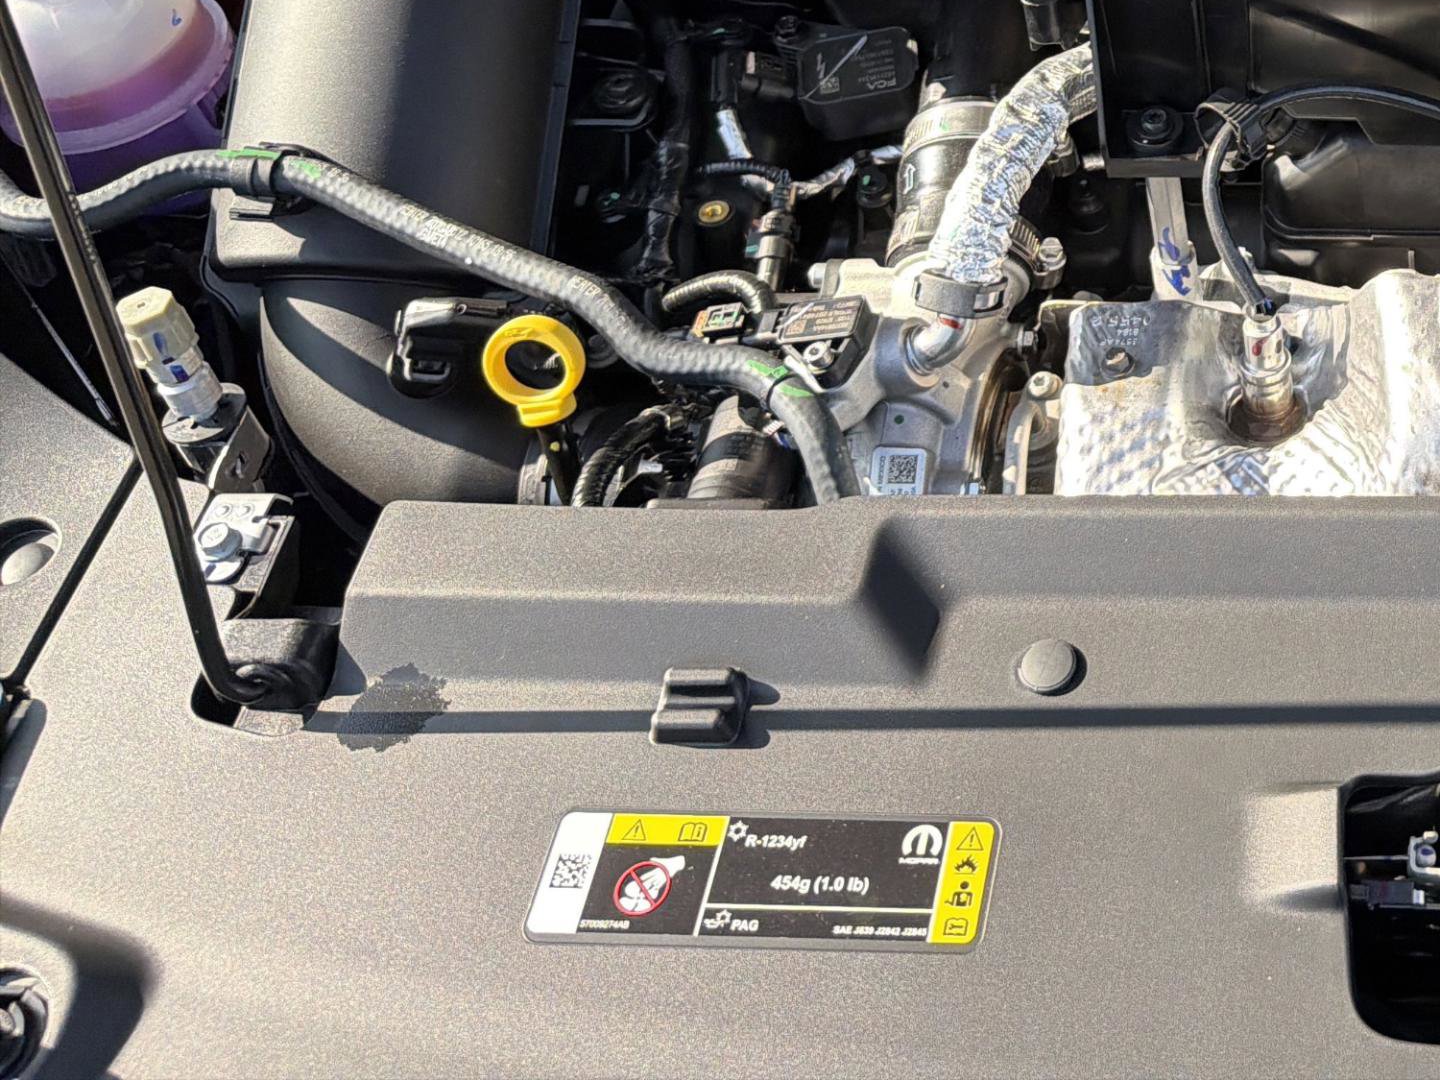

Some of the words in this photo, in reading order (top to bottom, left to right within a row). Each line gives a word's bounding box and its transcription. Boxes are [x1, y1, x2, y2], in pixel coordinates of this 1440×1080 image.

[744, 834, 808, 852] R-1234yf
[770, 874, 811, 894] 454g
[813, 874, 844, 895] (1.0
[846, 875, 870, 895] lb)
[730, 919, 759, 932] PAG
[833, 925, 853, 935] SAE
